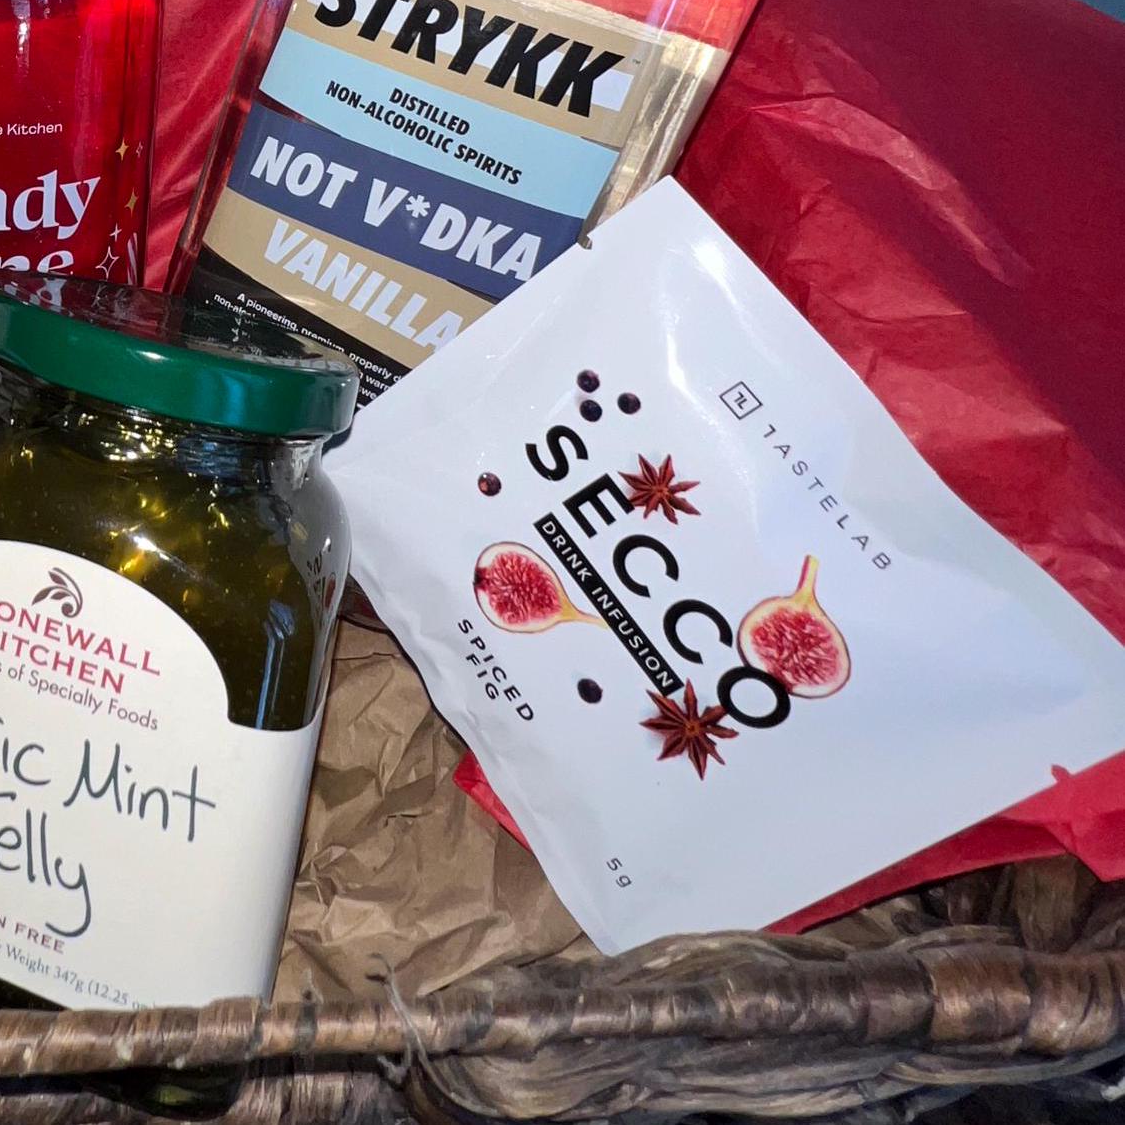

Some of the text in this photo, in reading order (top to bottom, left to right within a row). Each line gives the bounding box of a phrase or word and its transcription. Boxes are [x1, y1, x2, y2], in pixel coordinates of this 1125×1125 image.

[7, 121, 63, 136] Kitchen
[324, 79, 523, 185] NON-ALCOHOLIC SPIRITS
[388, 87, 470, 137] DISTILLED
[249, 136, 358, 209] NOT
[237, 293, 246, 303] A
[262, 218, 465, 353] VANILLA
[524, 424, 792, 729] SECCO
[541, 520, 675, 691] DRINK INFUSION
[7, 663, 26, 682] of
[28, 669, 104, 715] Specialty
[107, 698, 159, 731] Foods
[457, 618, 535, 722] SPICED
[465, 653, 499, 702] FIG
[63, 738, 217, 842] Mint
[14, 921, 67, 955] FREE
[5, 942, 51, 977] Weight
[52, 964, 84, 993] 347g
[87, 978, 128, 1006] (12.25
